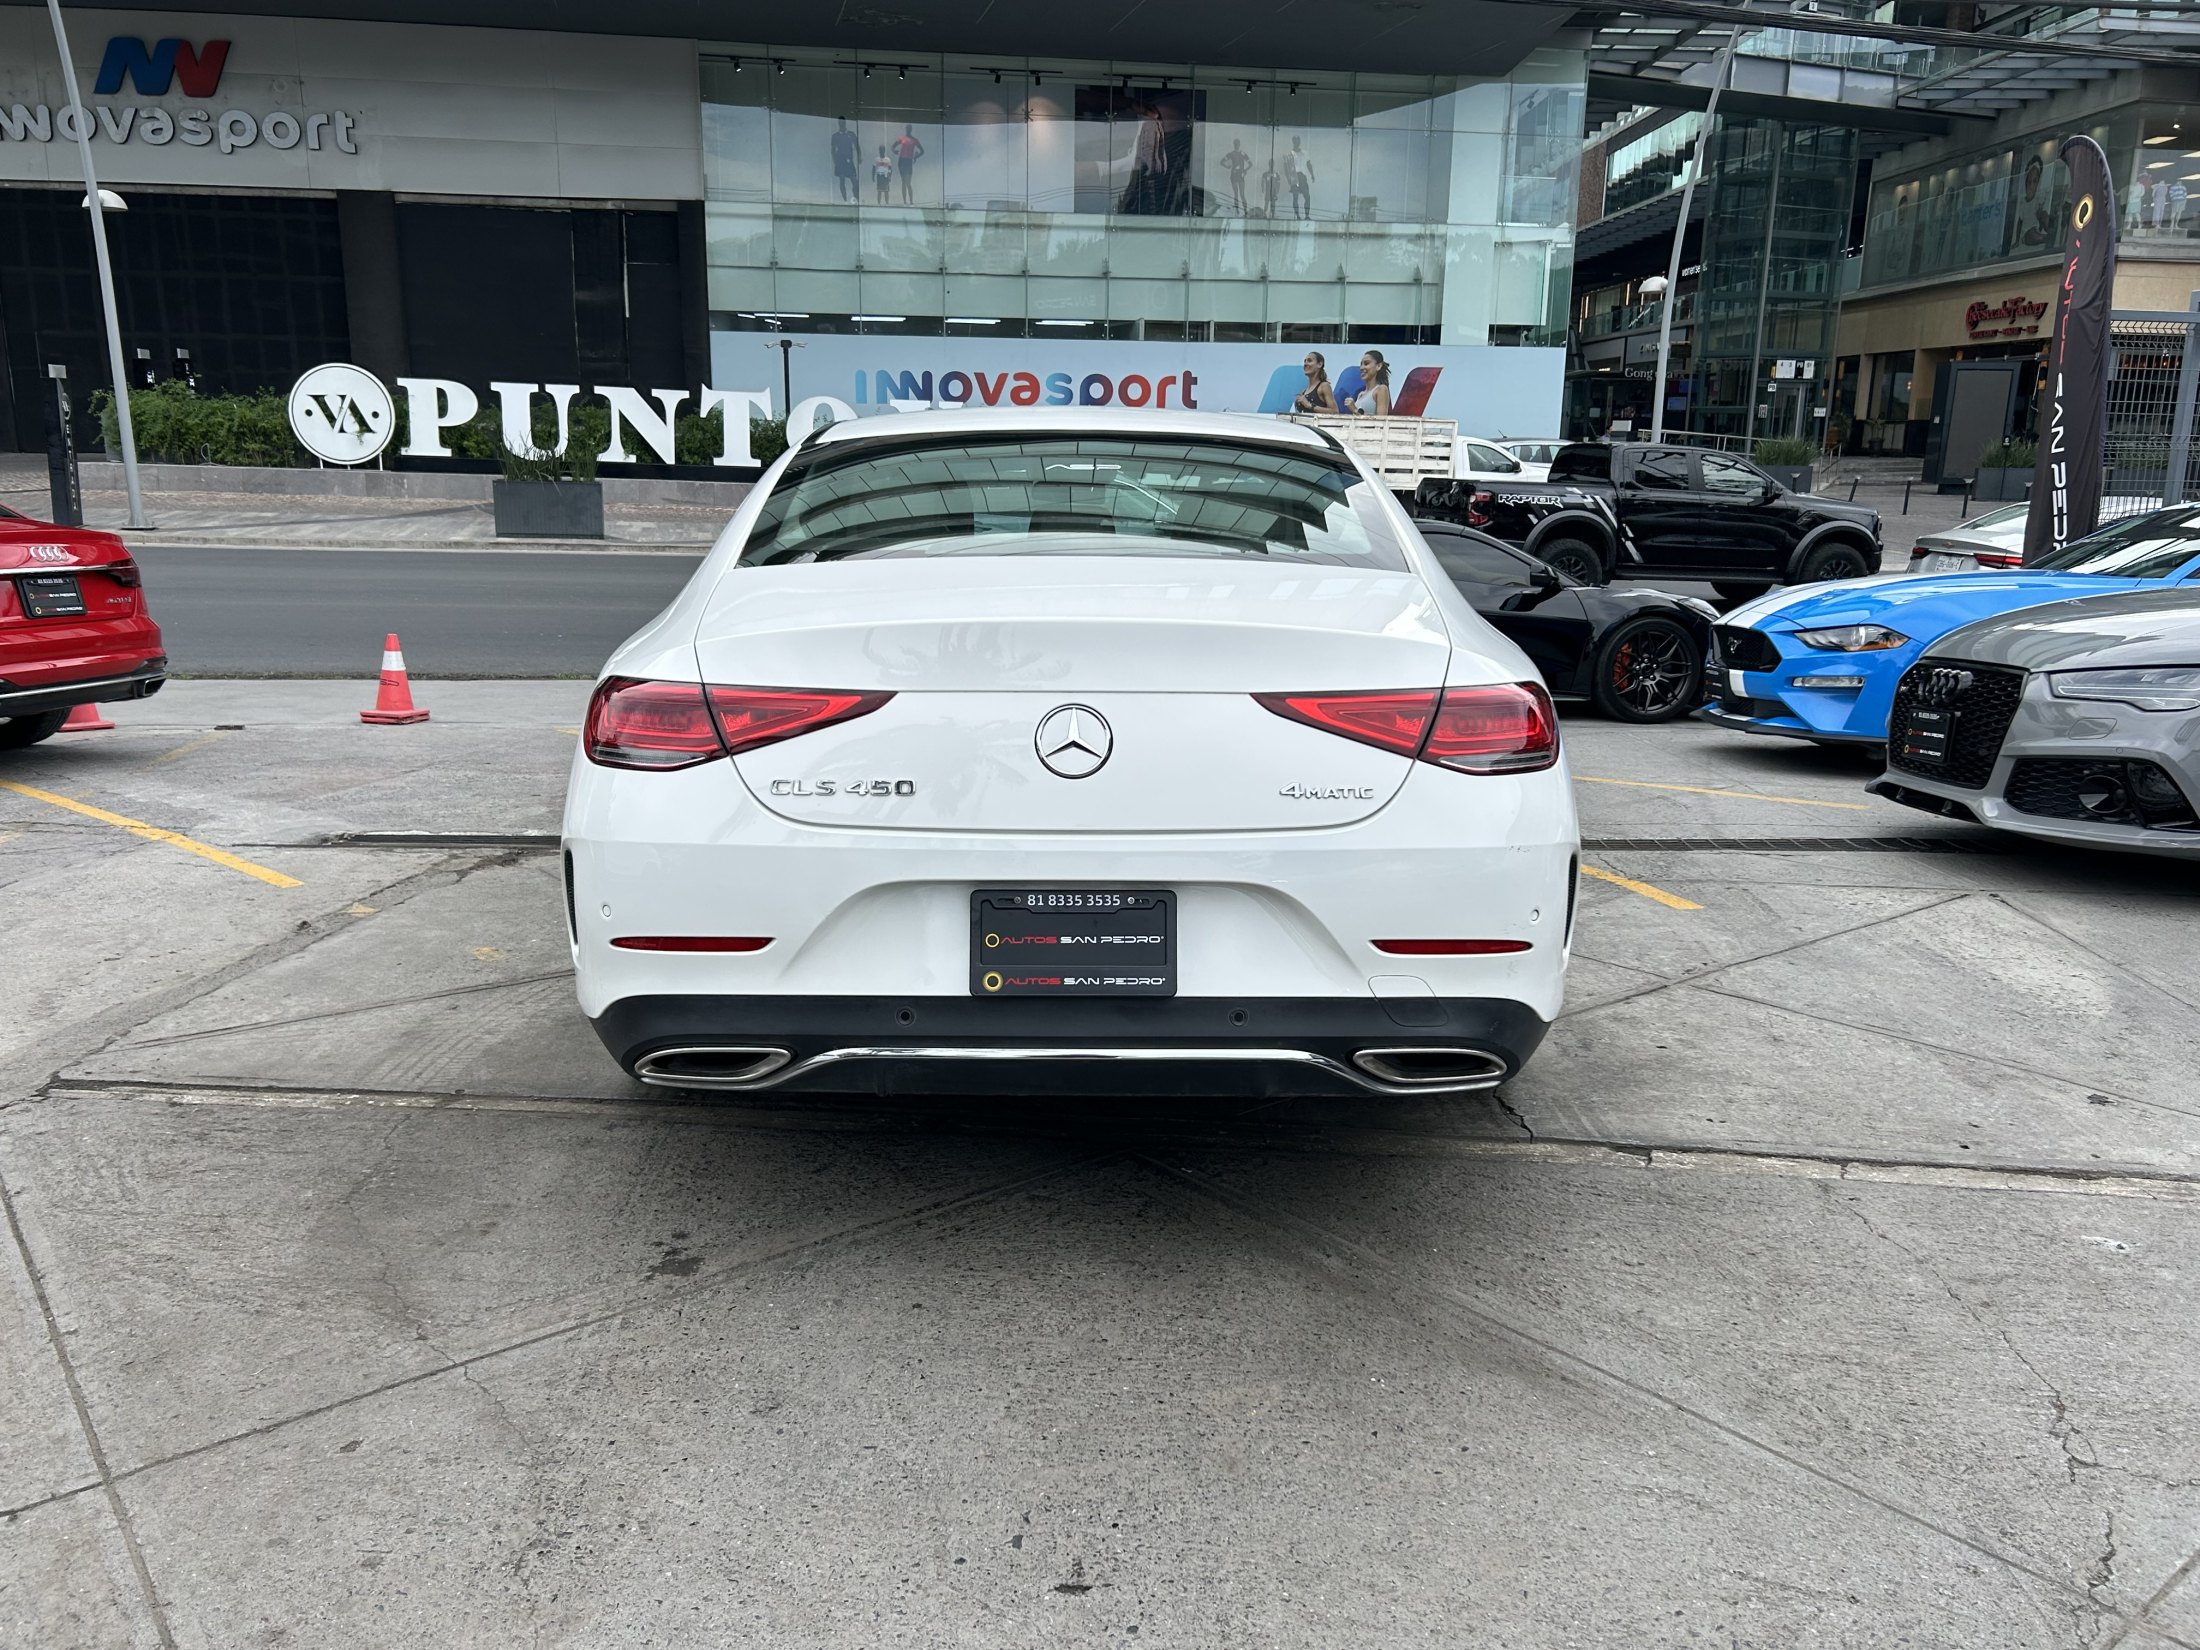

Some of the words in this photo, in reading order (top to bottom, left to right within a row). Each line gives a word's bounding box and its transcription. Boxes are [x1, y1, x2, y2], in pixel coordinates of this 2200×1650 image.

[1624, 368, 1653, 381] Gong
[1498, 494, 1564, 509] RAPTOR
[771, 779, 837, 796] CLS
[844, 780, 916, 796] 450
[1279, 782, 1374, 799] 4MATIC
[1027, 894, 1044, 906] 81
[1048, 894, 1083, 906] 8335
[1086, 894, 1121, 906] 3535
[1001, 936, 1057, 944] AUTOS
[1060, 936, 1097, 944] SAN
[1005, 977, 1061, 985] AUTOS
[1063, 977, 1100, 985] SAN
